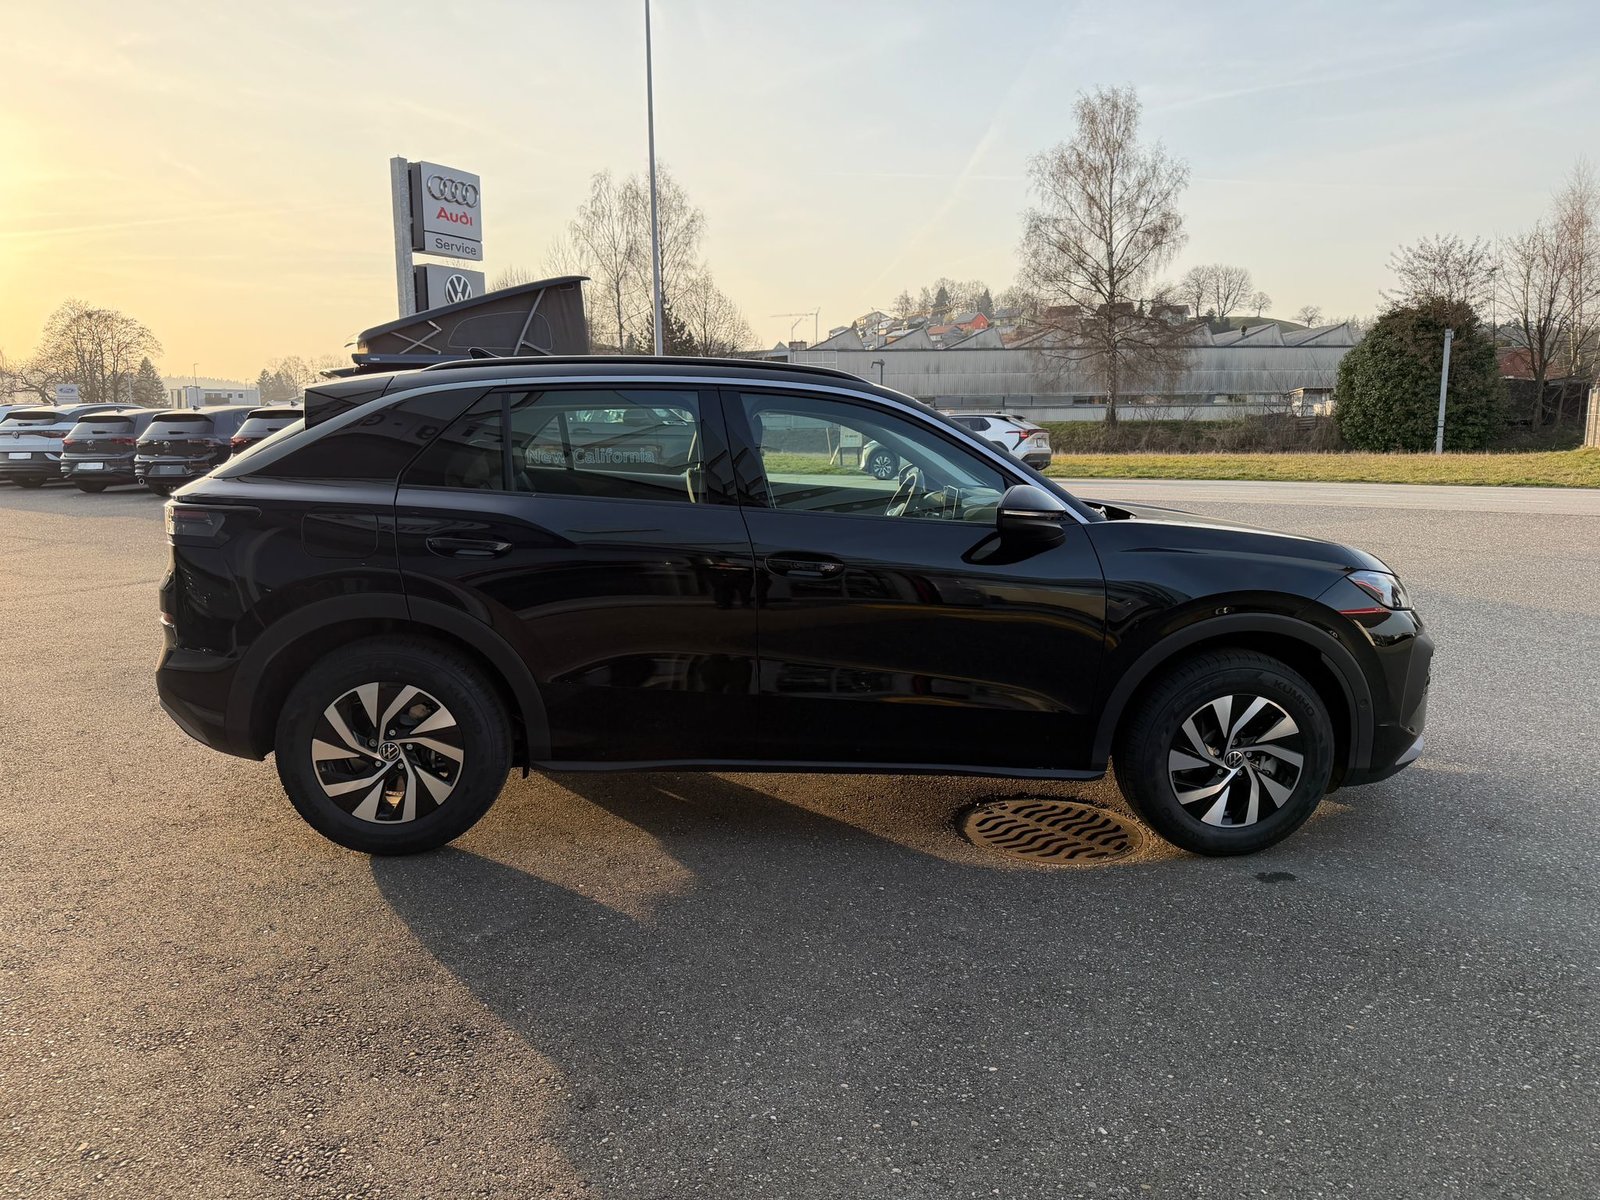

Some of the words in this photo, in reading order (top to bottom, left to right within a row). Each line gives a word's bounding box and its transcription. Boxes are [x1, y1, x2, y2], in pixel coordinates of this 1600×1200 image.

[436, 206, 473, 226] Audi
[435, 238, 477, 255] Service
[527, 450, 566, 464] New
[574, 447, 655, 464] California
[1273, 679, 1315, 717] KUMHO
